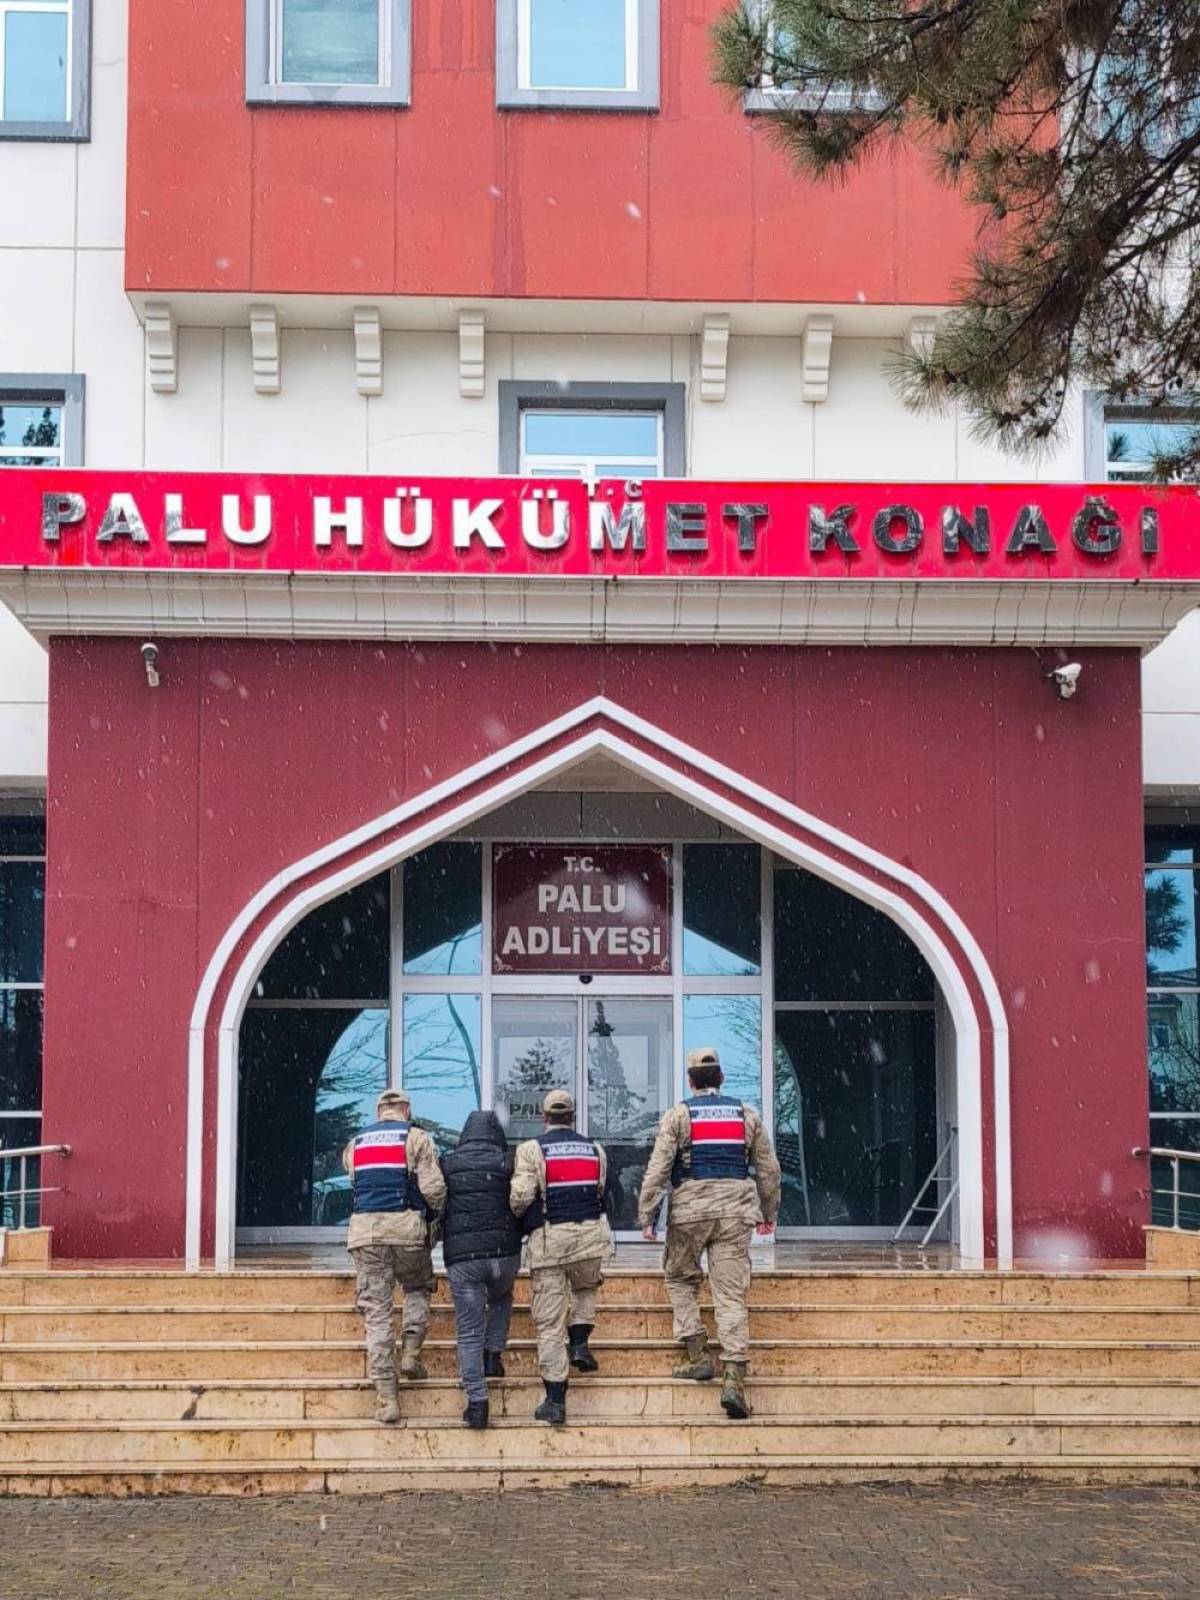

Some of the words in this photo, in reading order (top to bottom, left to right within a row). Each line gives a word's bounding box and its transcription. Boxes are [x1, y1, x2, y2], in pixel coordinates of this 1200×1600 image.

[42, 491, 272, 545] PALU
[313, 487, 769, 552] HÜKÜMET
[808, 496, 1160, 554] KONAĞI
[563, 857, 601, 872] T.C.
[538, 884, 626, 913] PALU
